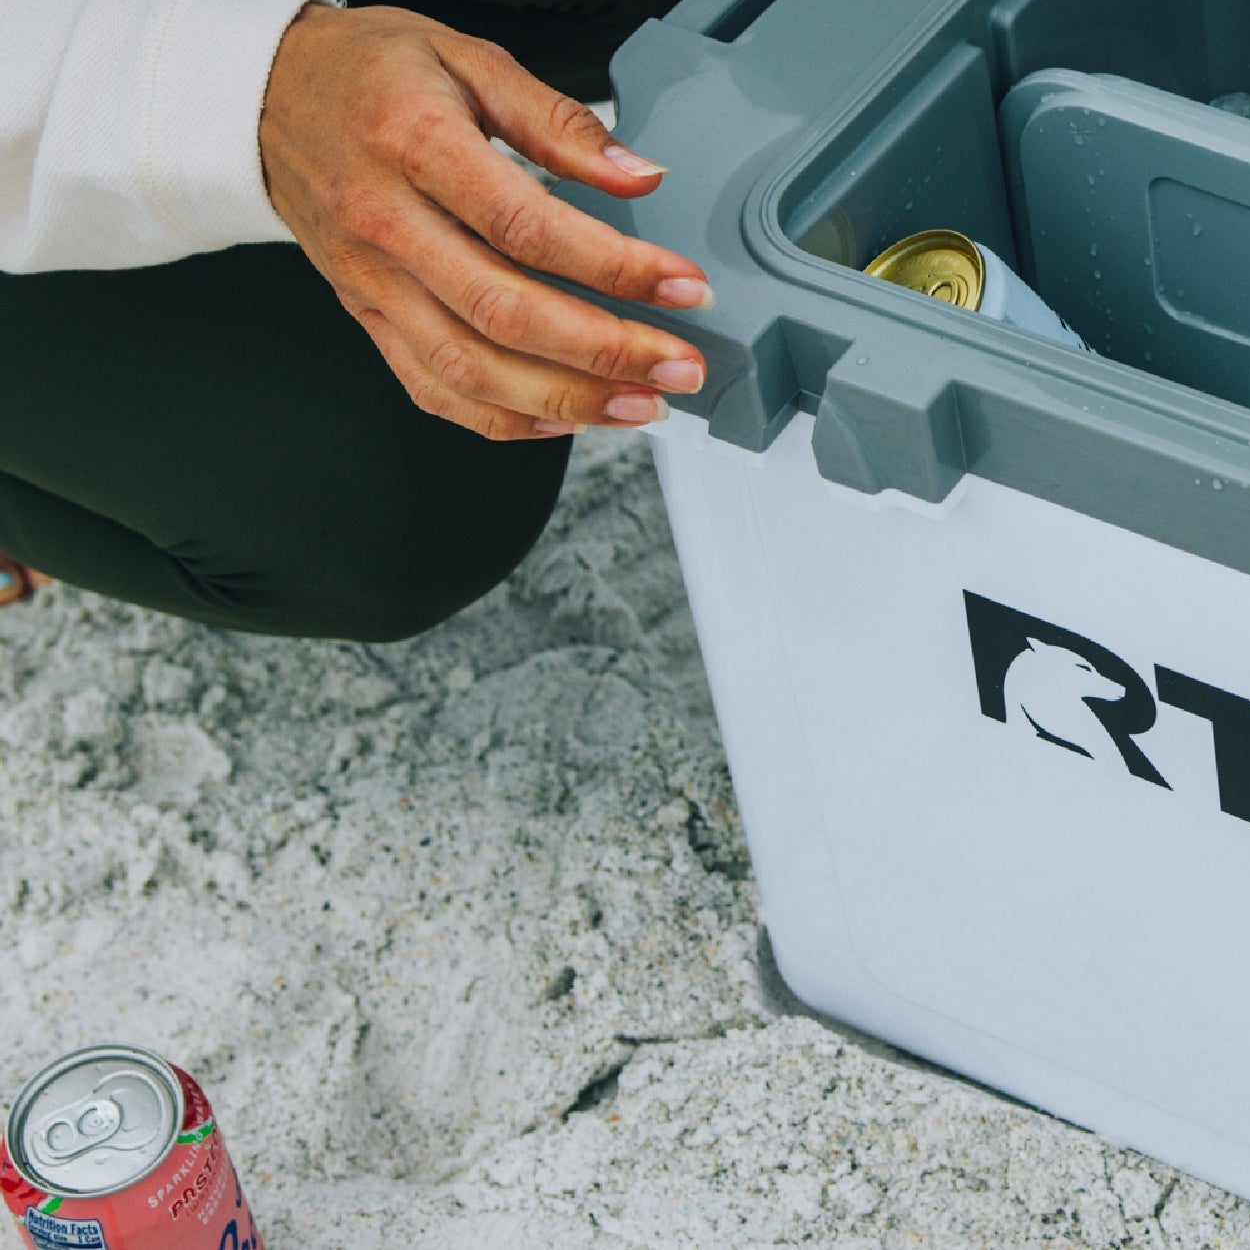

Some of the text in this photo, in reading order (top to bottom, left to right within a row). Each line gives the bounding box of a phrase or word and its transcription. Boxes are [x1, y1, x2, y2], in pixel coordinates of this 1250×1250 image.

[148, 1132, 204, 1209] SPARKLING
[29, 1209, 99, 1236] Nutrition Facts
